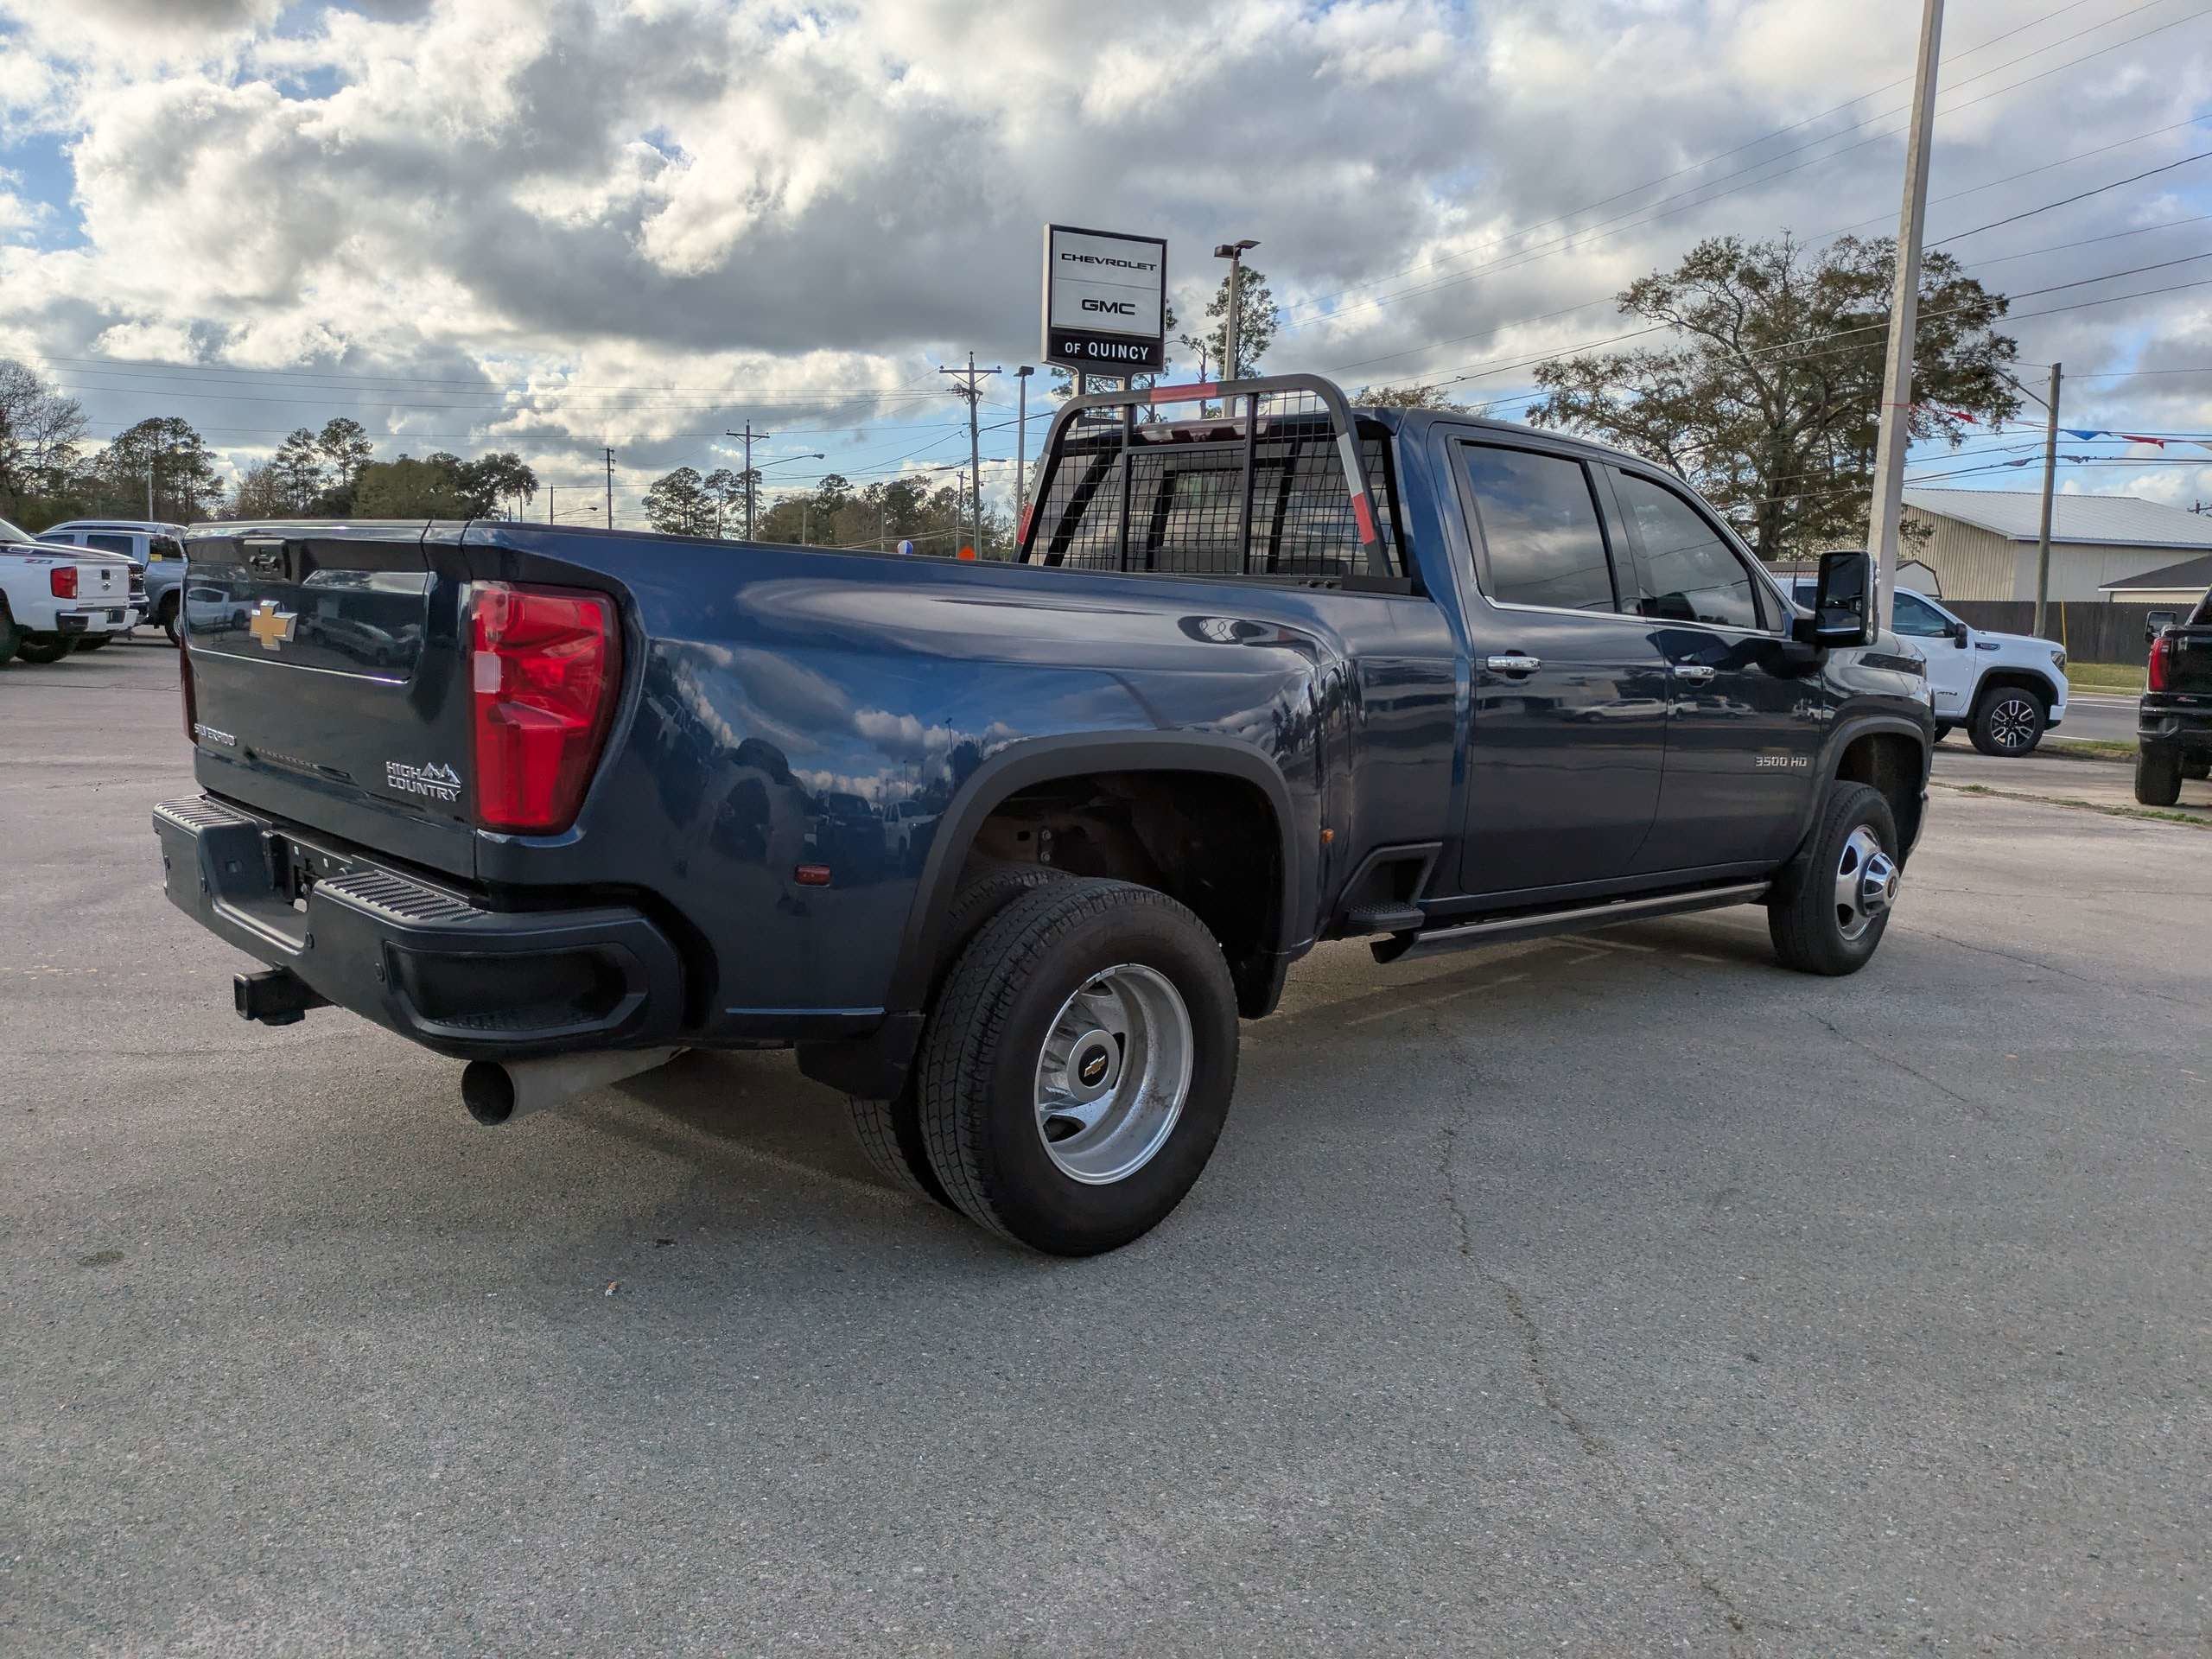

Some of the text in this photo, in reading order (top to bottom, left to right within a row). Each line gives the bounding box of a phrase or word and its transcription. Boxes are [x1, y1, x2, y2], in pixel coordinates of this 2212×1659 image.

[1061, 252, 1157, 271] CHEVROLET
[1081, 298, 1136, 316] GMC
[1065, 342, 1149, 360] OF QUINCY
[385, 760, 421, 779] HIGH
[1755, 756, 1808, 766] 3500 HD
[387, 774, 461, 802] COUNTRY
